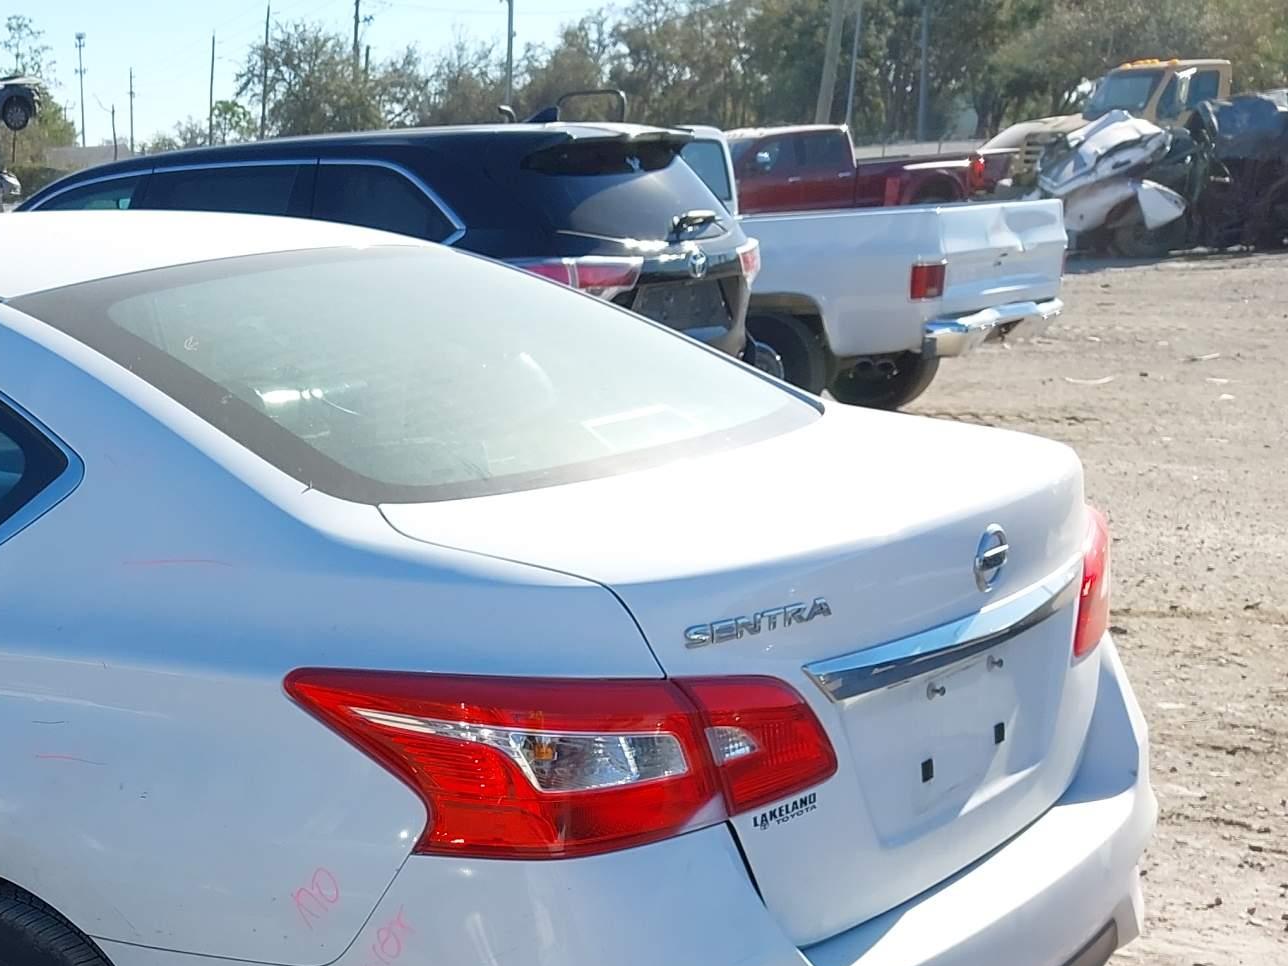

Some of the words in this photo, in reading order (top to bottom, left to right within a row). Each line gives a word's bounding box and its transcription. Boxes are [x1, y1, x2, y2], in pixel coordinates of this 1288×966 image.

[683, 596, 833, 649] SENTRA
[752, 792, 817, 828] LAKELAND
[775, 804, 817, 825] TOYOTA
